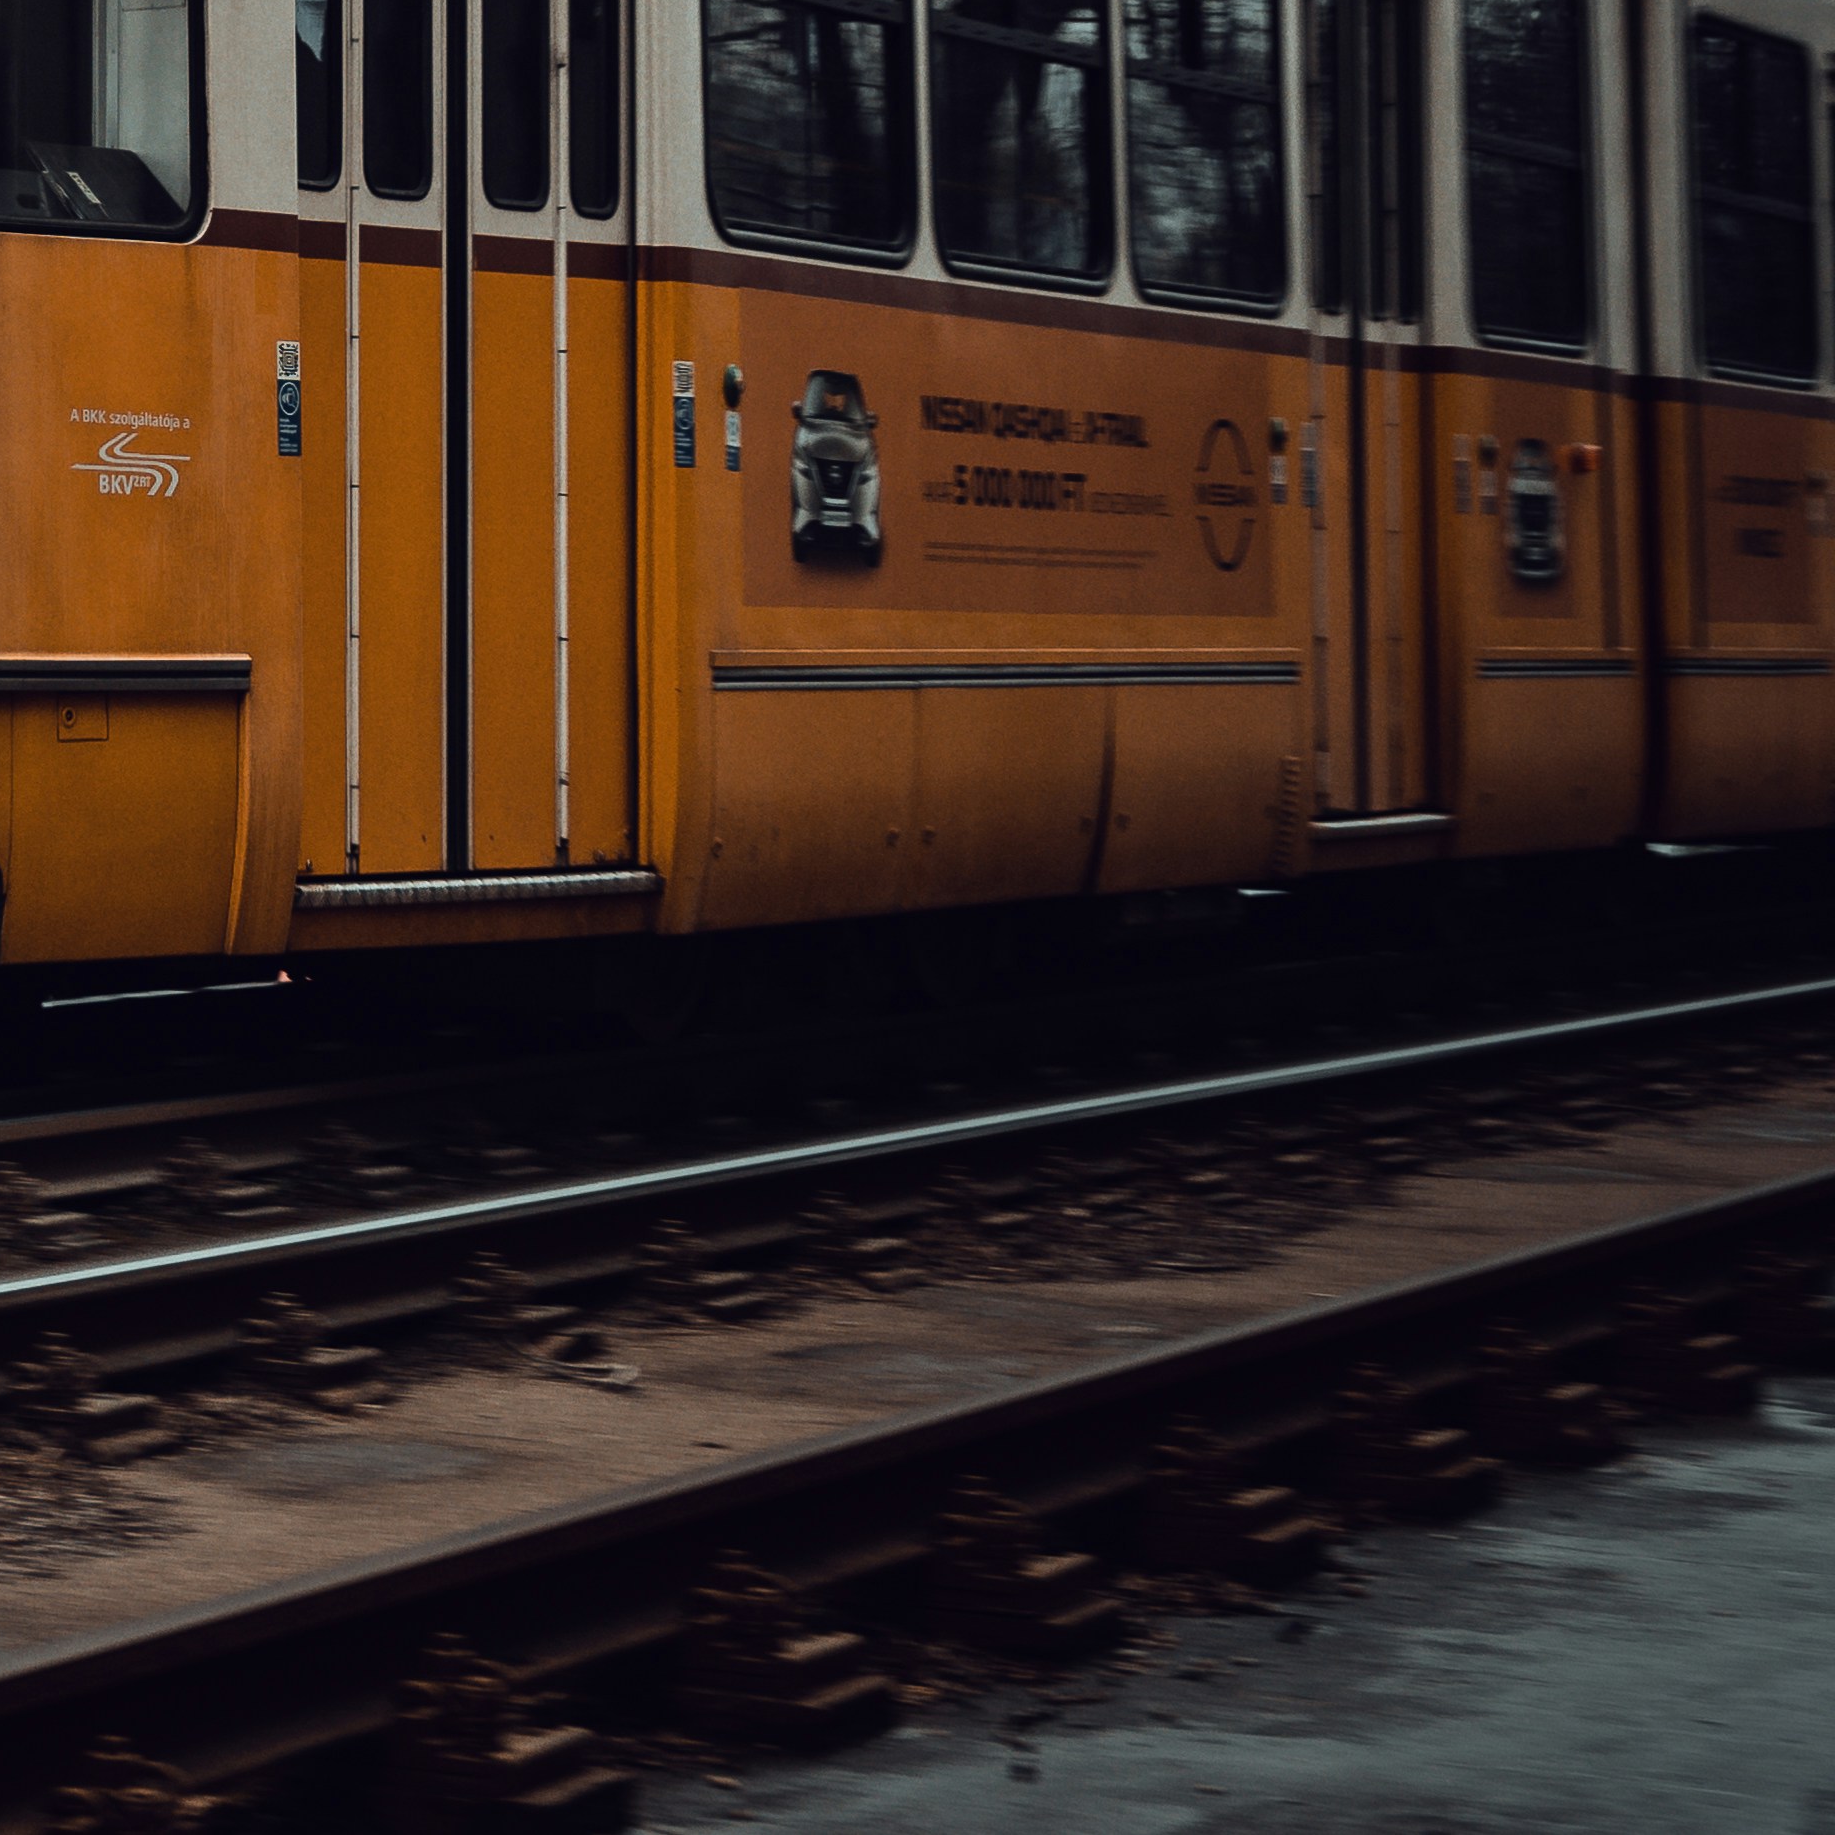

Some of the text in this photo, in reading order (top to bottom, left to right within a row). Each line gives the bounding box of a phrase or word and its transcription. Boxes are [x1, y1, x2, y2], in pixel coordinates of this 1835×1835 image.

[70, 409, 190, 431] A BKK szolgáltatója a
[99, 474, 132, 495] BKV
